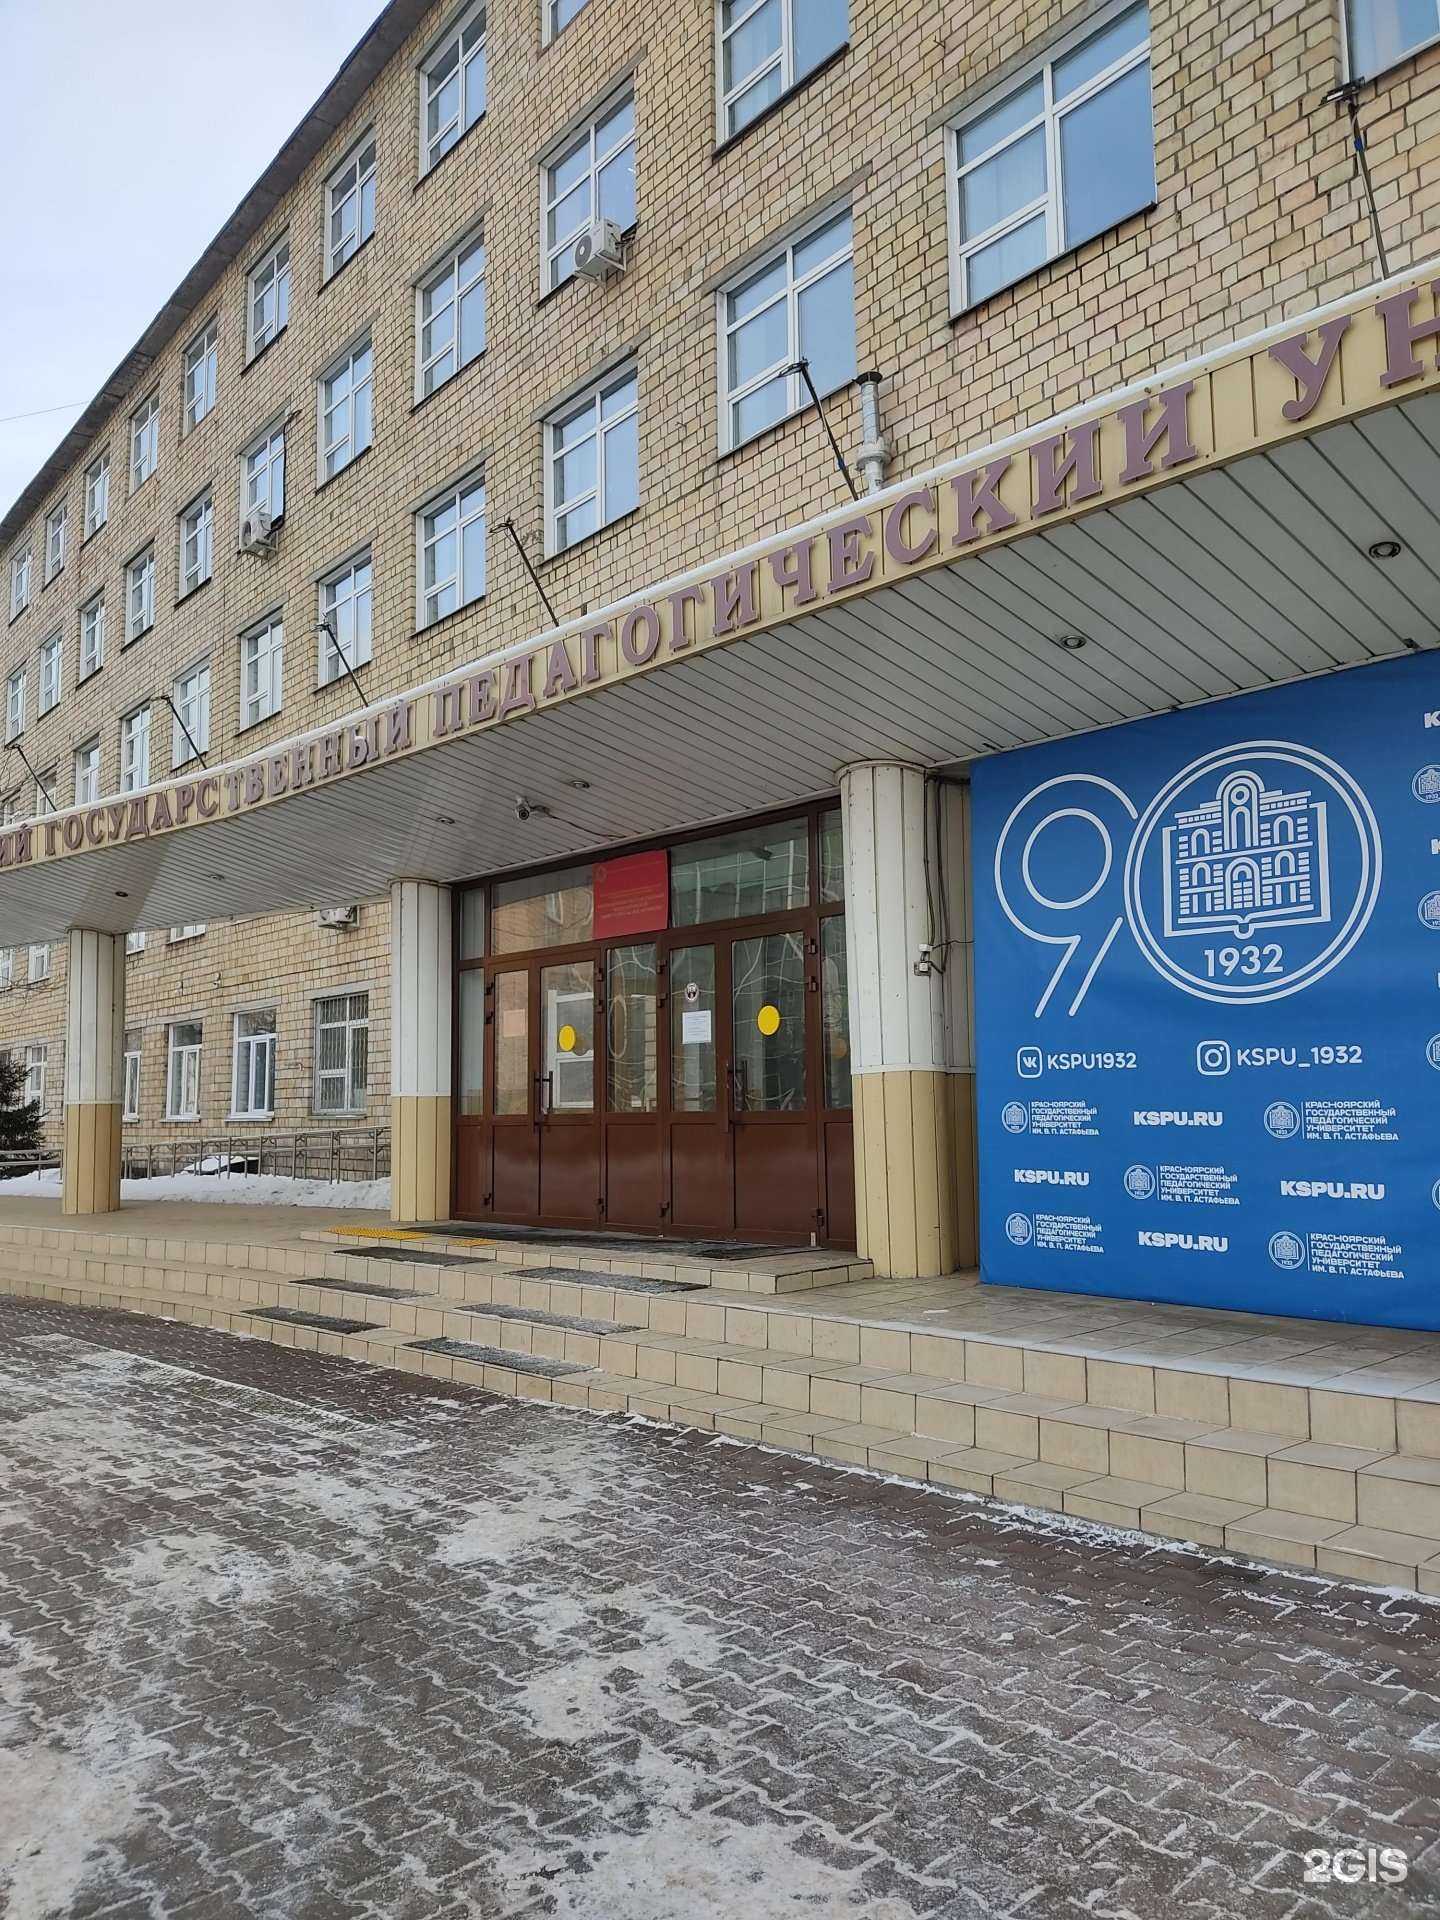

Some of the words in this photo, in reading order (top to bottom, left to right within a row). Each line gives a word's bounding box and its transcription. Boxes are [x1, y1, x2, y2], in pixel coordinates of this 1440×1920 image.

[45, 699, 411, 857] ГОСУДАРСТВЕННЫЙ
[1204, 943, 1284, 977] 1932
[1047, 1052, 1137, 1070] KSPU1932
[1237, 1045, 1363, 1068] KSPU_1932
[1306, 1100, 1380, 1108] КРАСНОЯРСКИЙ
[1306, 1108, 1396, 1116] ГОСУДАРСТВЕННЫЙ
[1133, 1111, 1223, 1126] KSPU.RU
[1306, 1116, 1388, 1124] ПЕДАГОГИЧЕСКИЙ
[1160, 1166, 1224, 1174] КРАСНОЯРСКИЙ
[1014, 1169, 1090, 1186] KSPU.RU
[1160, 1173, 1238, 1182] ГОСУДАРСТВЕННЫЙ
[1161, 1180, 1230, 1189] ПЕДАГОГИЧЕСКИЙ
[1280, 1180, 1385, 1200] KSPU.RU
[1161, 1188, 1219, 1196] УНИВЕРСИТЕТ
[1138, 1231, 1228, 1252] KSPU.RU
[1311, 1233, 1385, 1244] КРАСНОЯРСКИЙ
[1311, 1242, 1401, 1254] ГОСУДАРСТВЕННЫЙ
[1312, 1250, 1394, 1261] ПЕДАГОГИЧЕСКИЙ
[1312, 1257, 1380, 1268] УНИВЕРСИТЕТ
[1351, 1268, 1404, 1278] АСТАФЬЕВА
